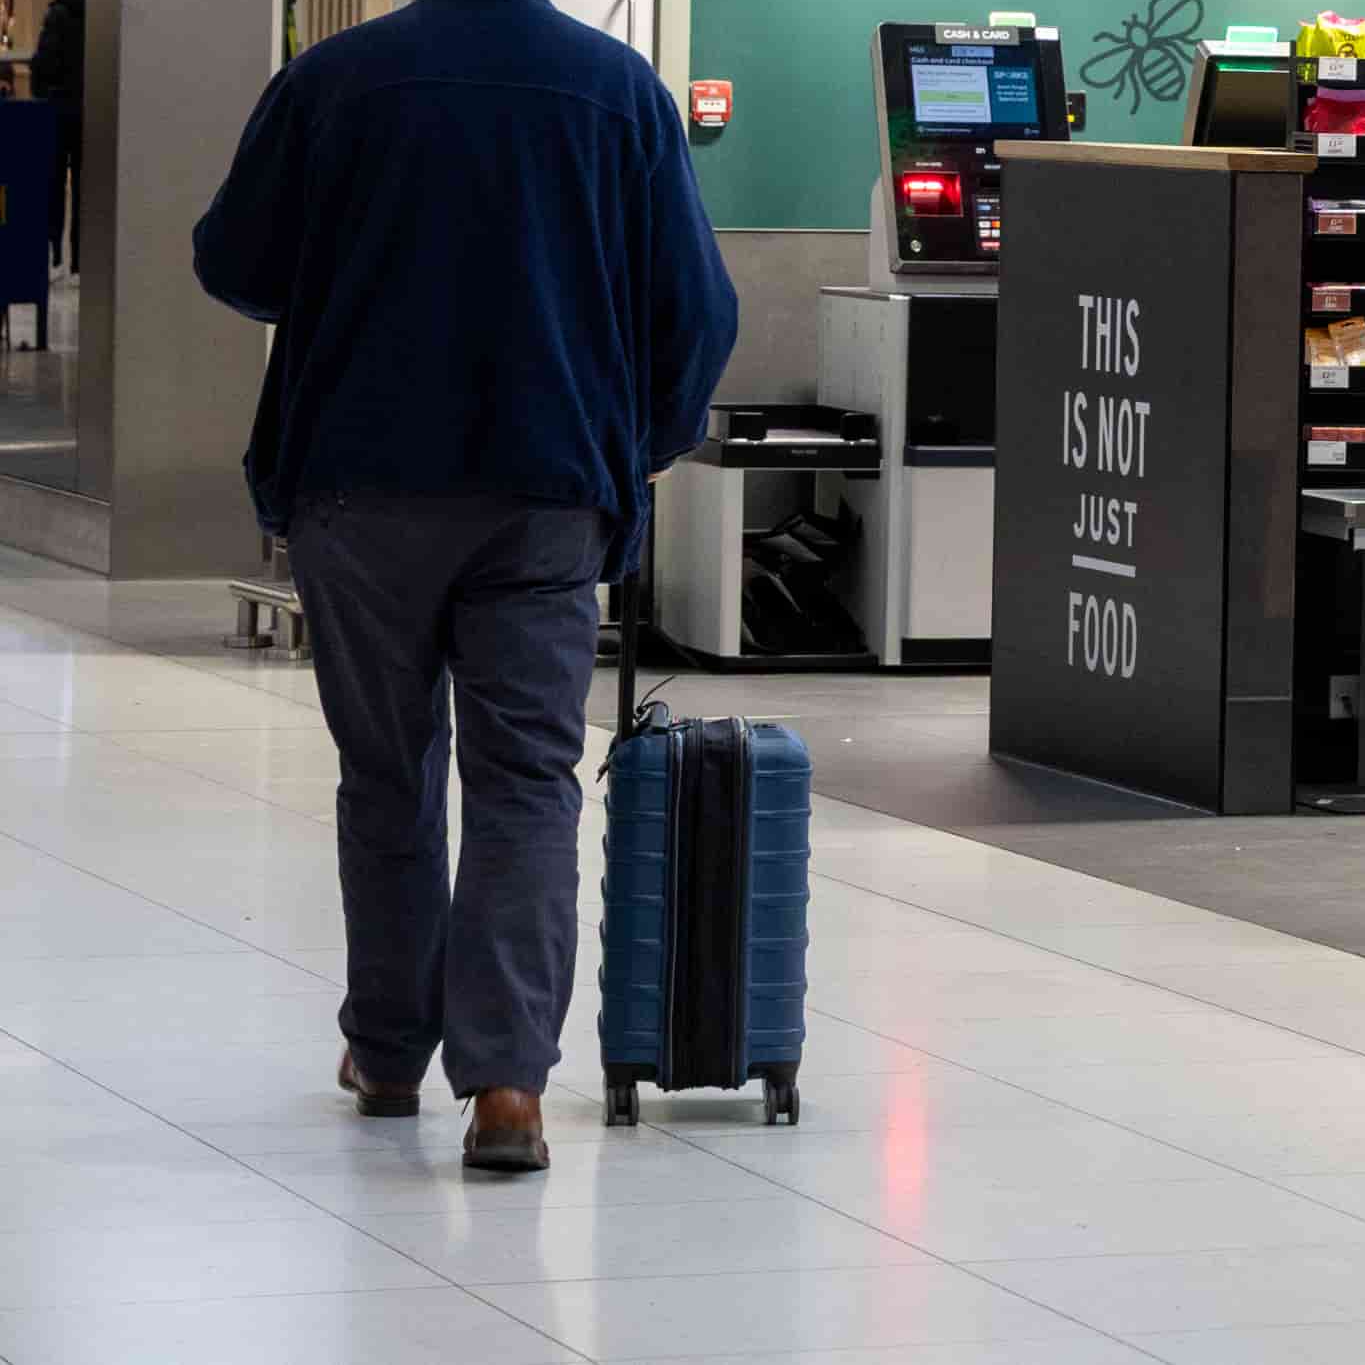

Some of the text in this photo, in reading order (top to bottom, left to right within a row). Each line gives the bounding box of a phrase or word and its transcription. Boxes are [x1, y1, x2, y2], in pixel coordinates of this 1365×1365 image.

[943, 29, 971, 39] CASH
[982, 30, 1010, 39] CARD
[1077, 293, 1141, 377] THIS
[1063, 390, 1151, 478] IS NOT
[1073, 493, 1138, 548] JUST
[1067, 591, 1138, 679] FOOD
